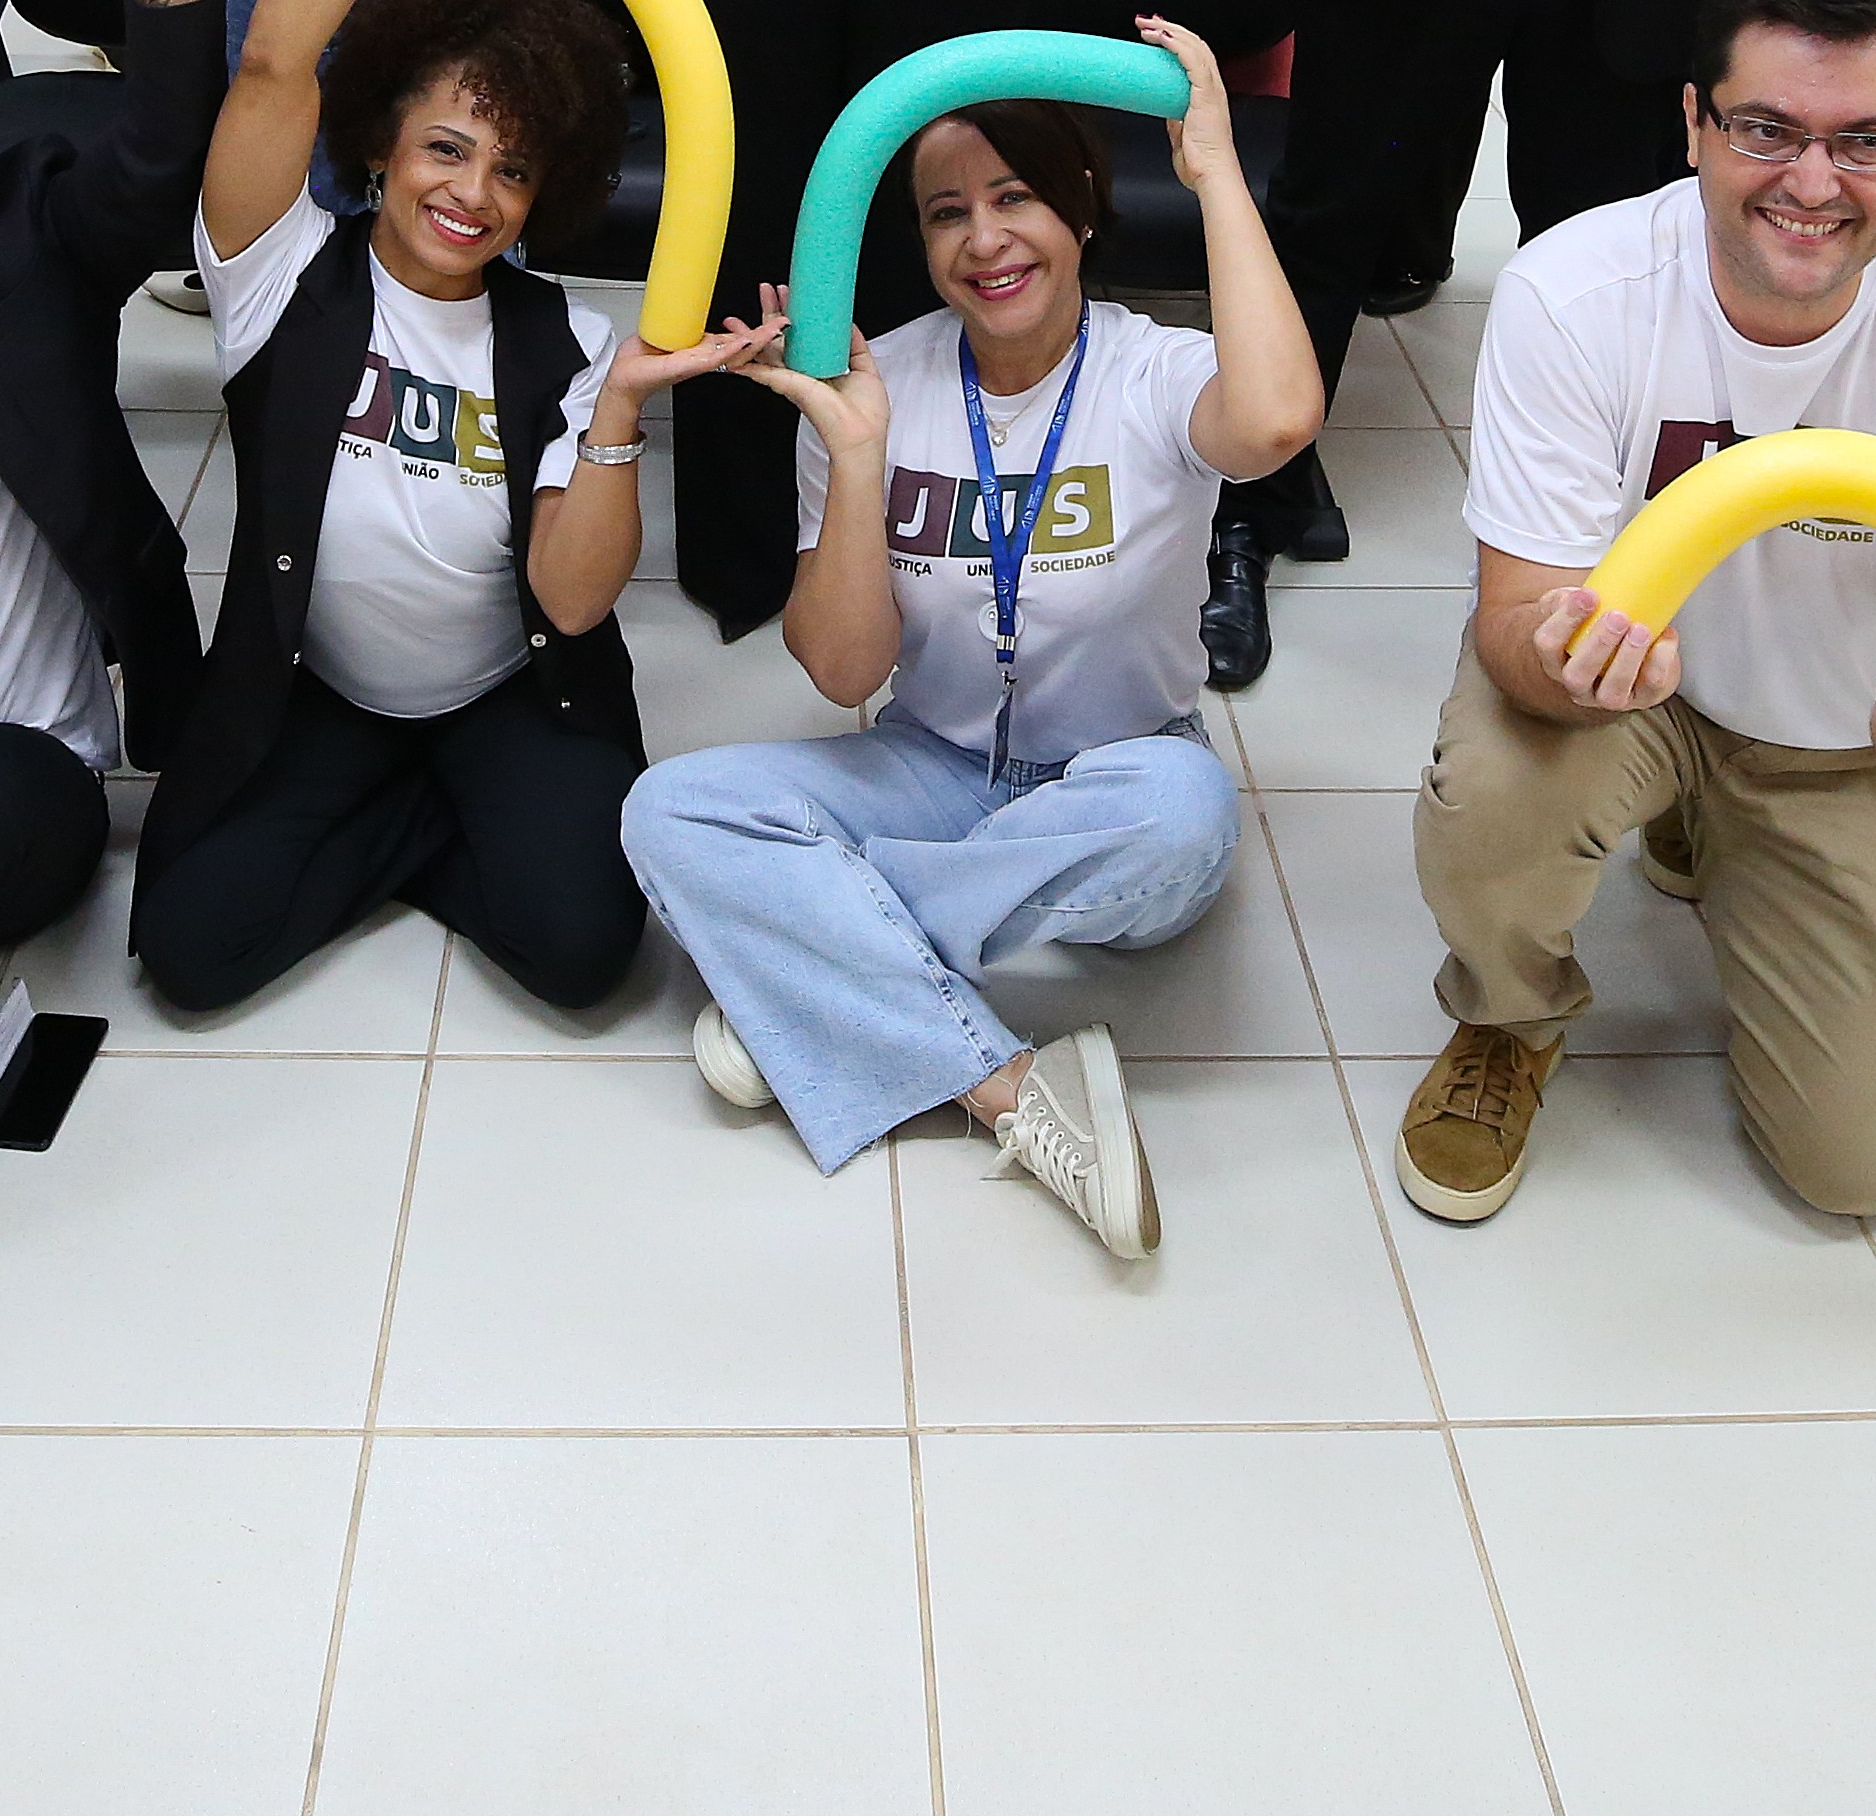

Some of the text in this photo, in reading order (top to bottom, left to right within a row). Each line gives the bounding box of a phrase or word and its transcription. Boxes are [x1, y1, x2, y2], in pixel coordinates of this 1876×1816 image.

[345, 366, 506, 461] JUS
[339, 438, 373, 460] TIÇA
[402, 462, 440, 481] NIÃO
[888, 551, 1116, 577] USTIÇA UNI SOCIEDADE
